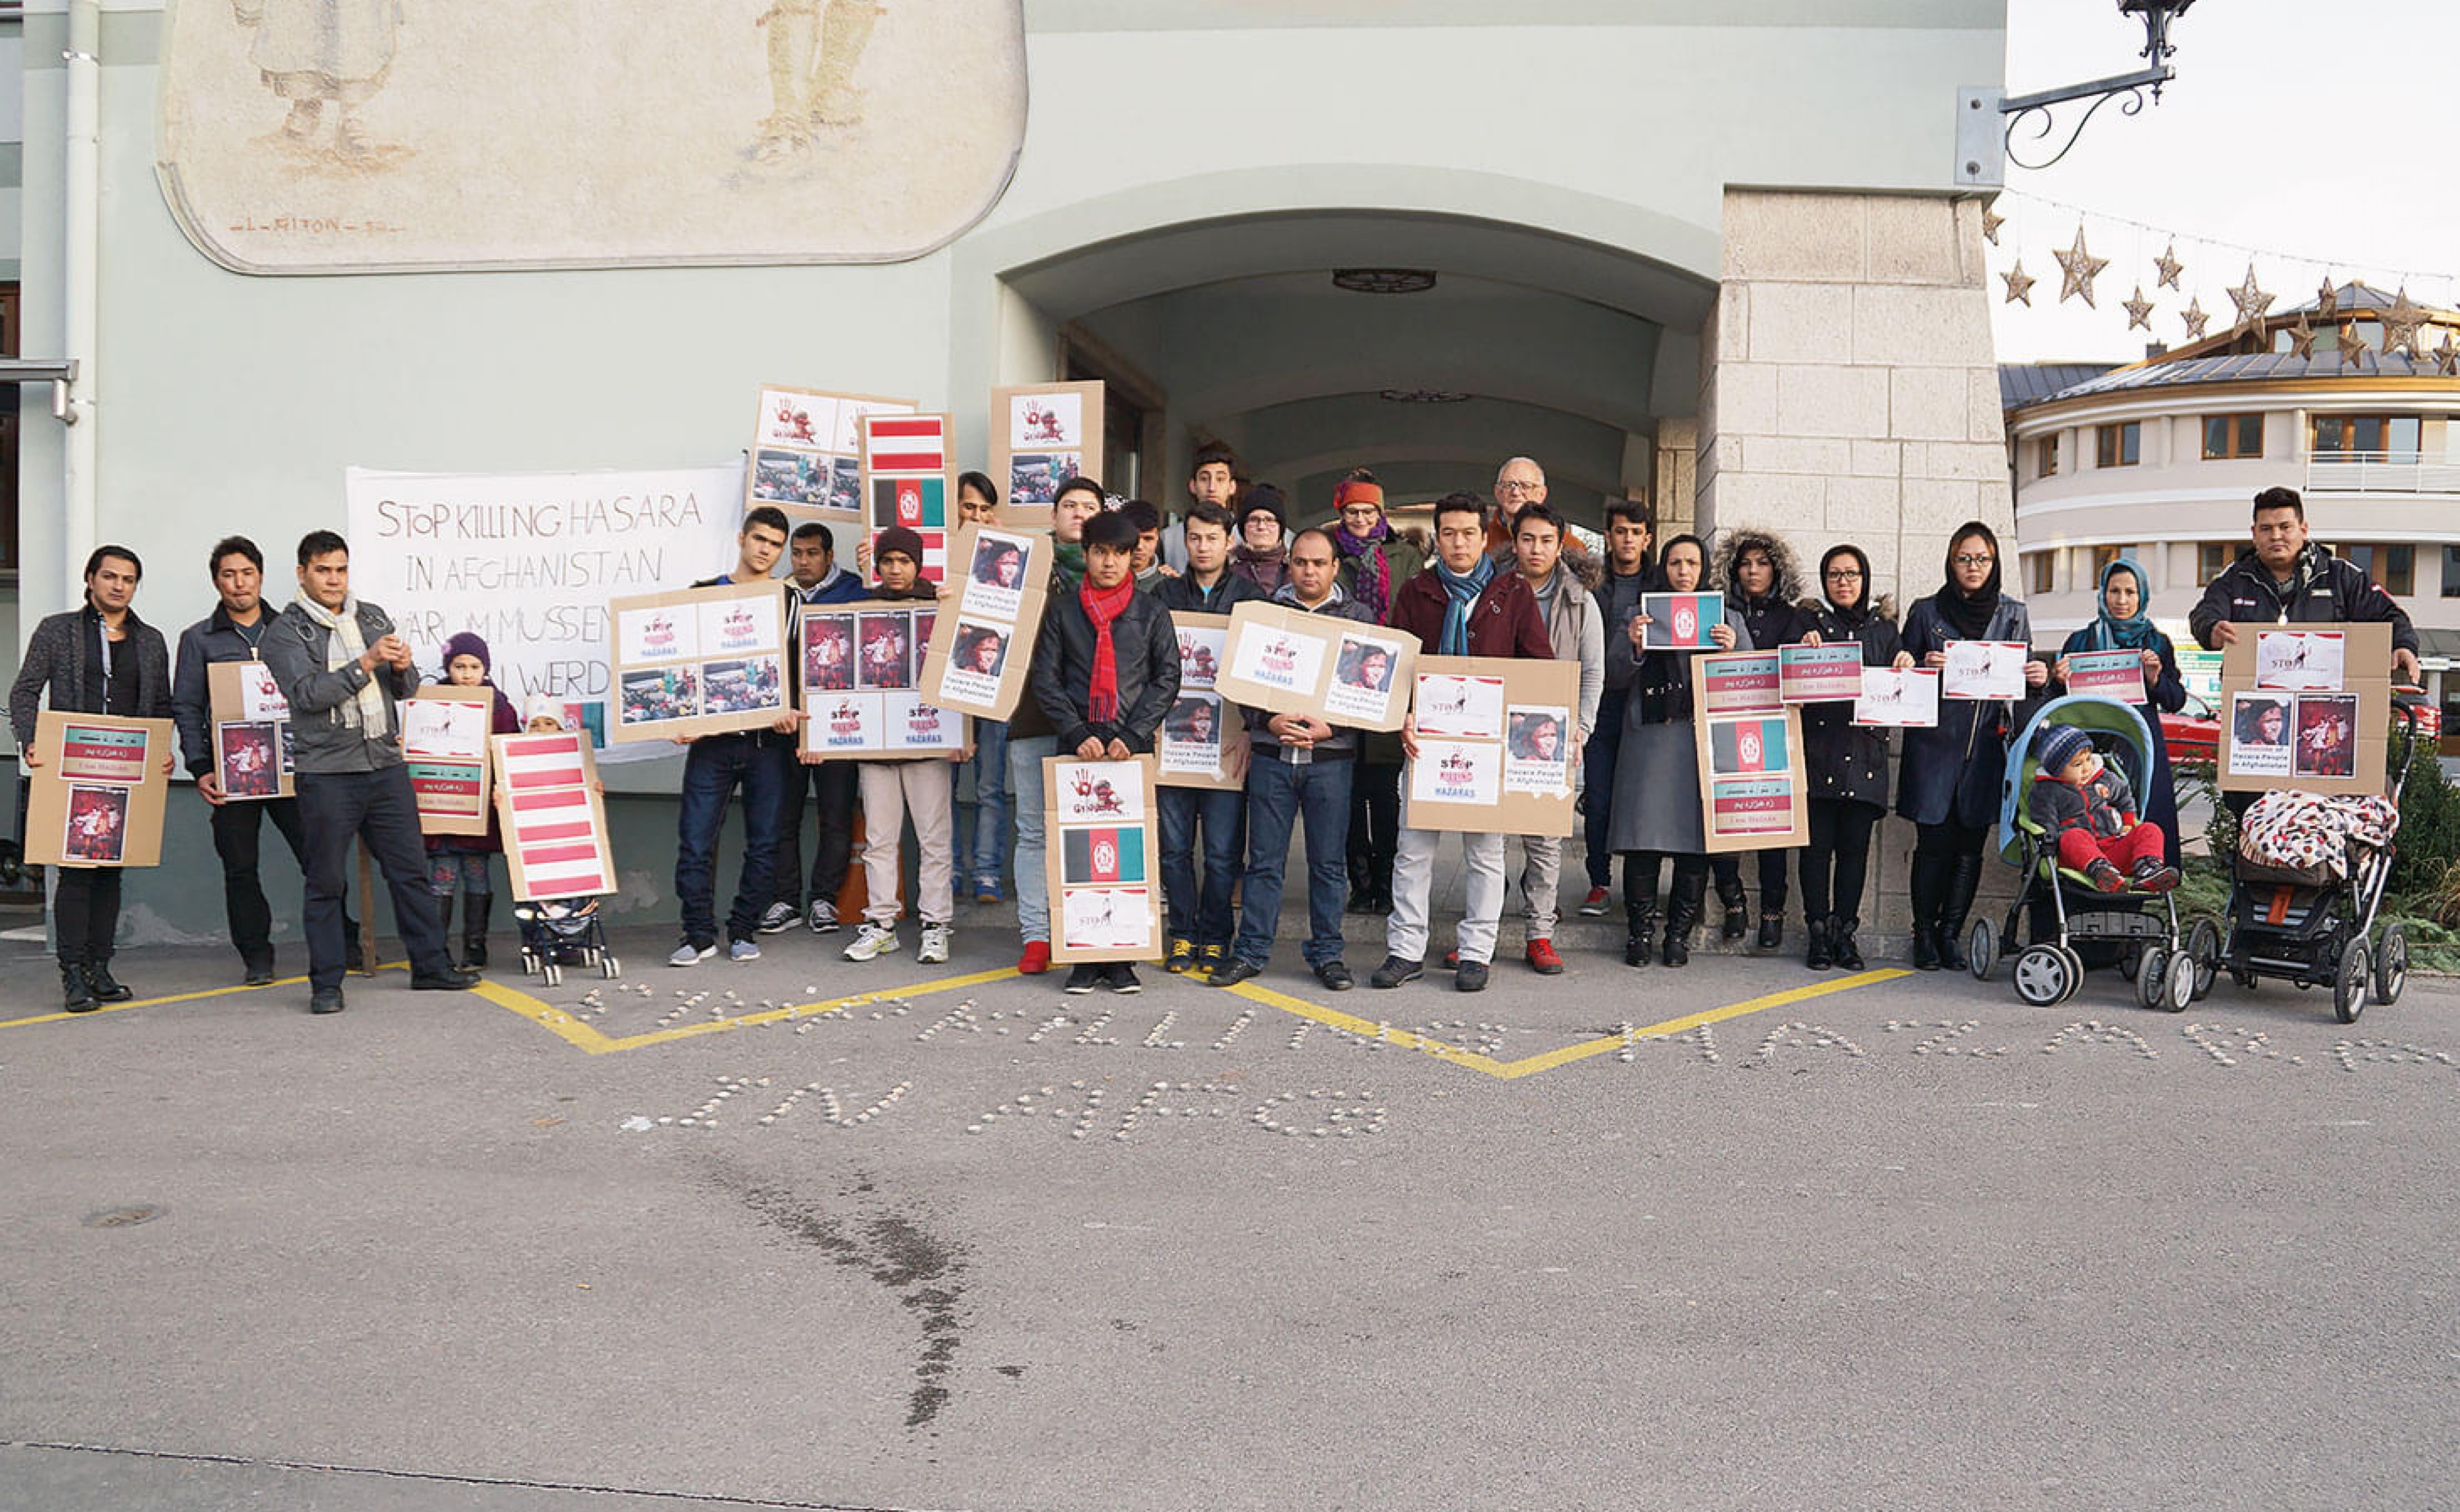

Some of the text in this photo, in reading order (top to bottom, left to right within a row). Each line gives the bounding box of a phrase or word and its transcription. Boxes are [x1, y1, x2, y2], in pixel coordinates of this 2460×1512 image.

[377, 491, 702, 539] STOP KILLING HASARA
[405, 547, 664, 591] IN AFGHANISTAN
[658, 1075, 914, 1130] IN
